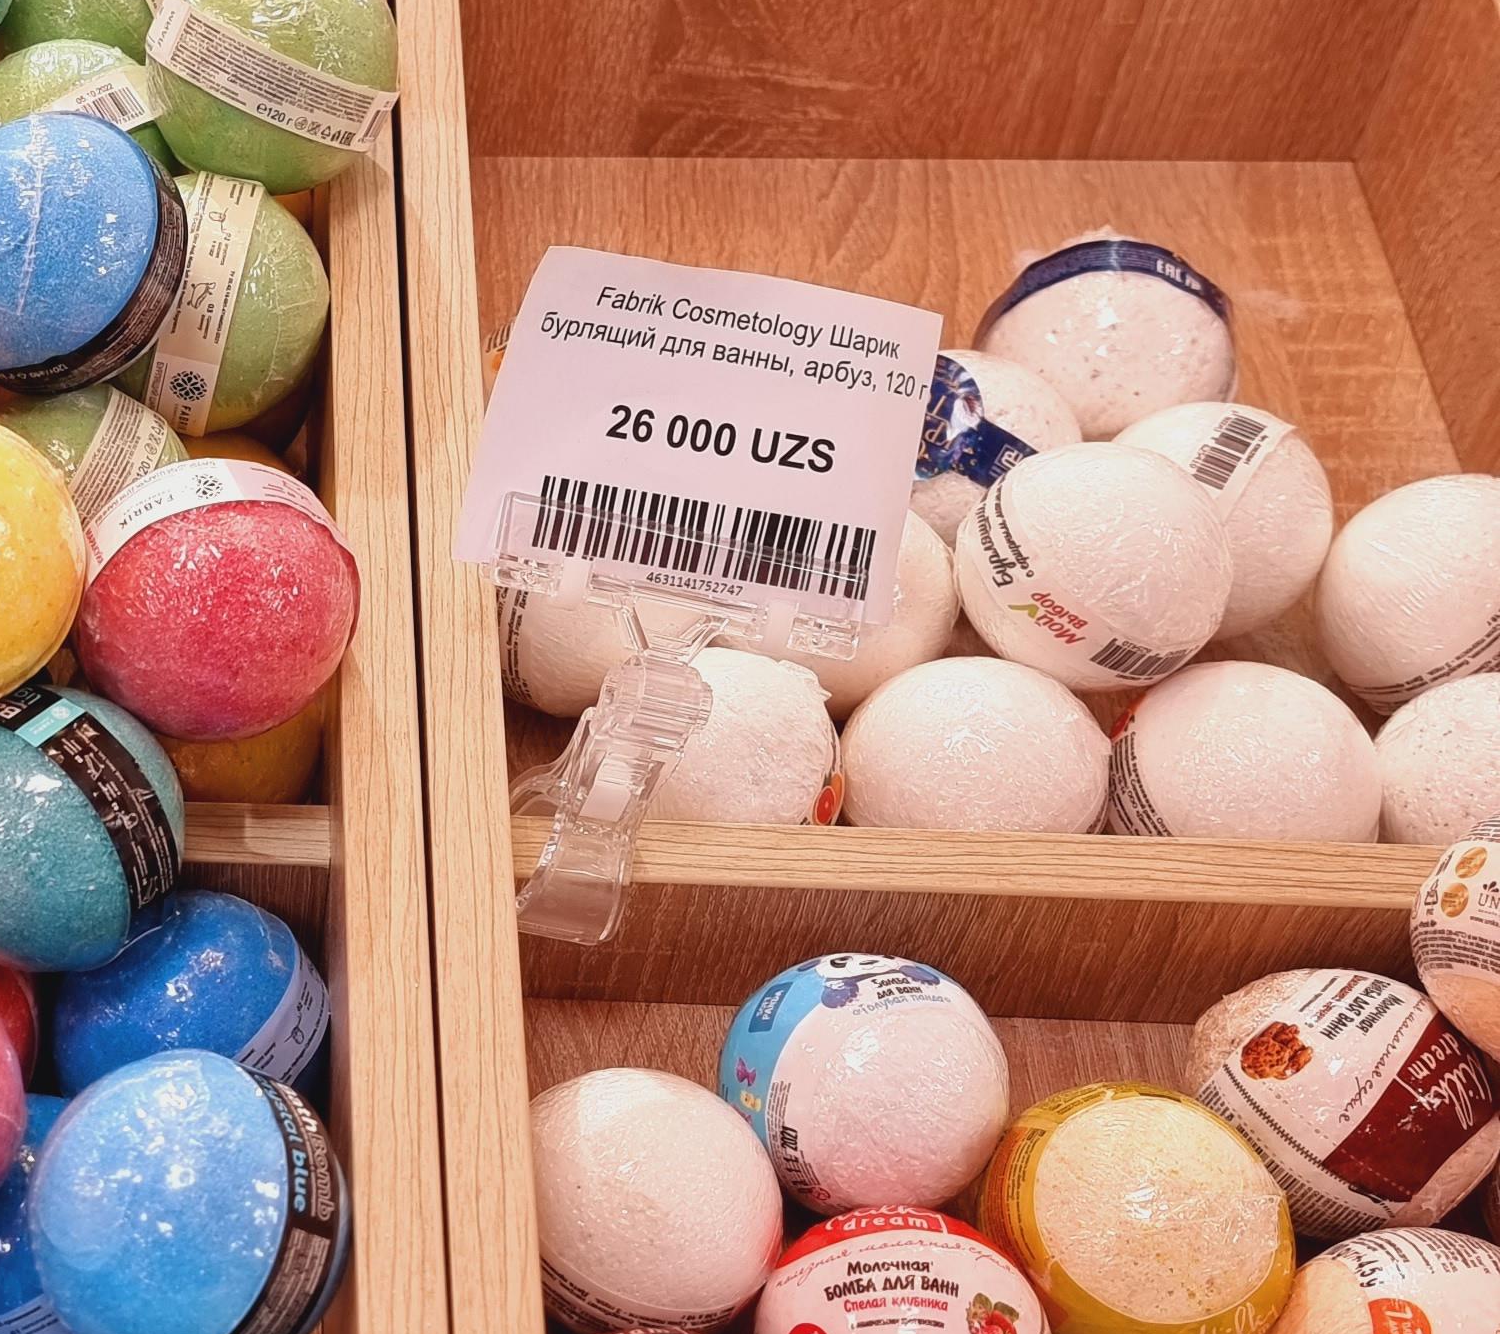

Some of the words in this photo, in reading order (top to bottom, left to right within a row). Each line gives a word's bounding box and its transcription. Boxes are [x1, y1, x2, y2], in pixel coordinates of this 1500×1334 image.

[596, 286, 664, 317] Fabrik
[672, 297, 823, 349] Cosmetology
[829, 325, 901, 360] Шарик
[540, 311, 656, 351] бурлящий
[660, 331, 707, 359] для
[712, 342, 796, 378] ванны,
[803, 359, 878, 392] арбуз,
[885, 370, 917, 399] 120
[918, 381, 928, 402] г
[605, 404, 655, 443] 26
[666, 413, 736, 457] 000
[750, 426, 836, 475] UZS
[645, 570, 744, 597] 4631141752747
[1320, 1012, 1351, 1042] ВАНН
[1406, 1033, 1460, 1082] dream
[288, 1149, 309, 1215] blue
[842, 1210, 930, 1240] dream
[823, 1275, 877, 1306] БОМБА
[881, 1273, 917, 1293] ДЛЯ
[919, 1277, 961, 1297] ВАНН
